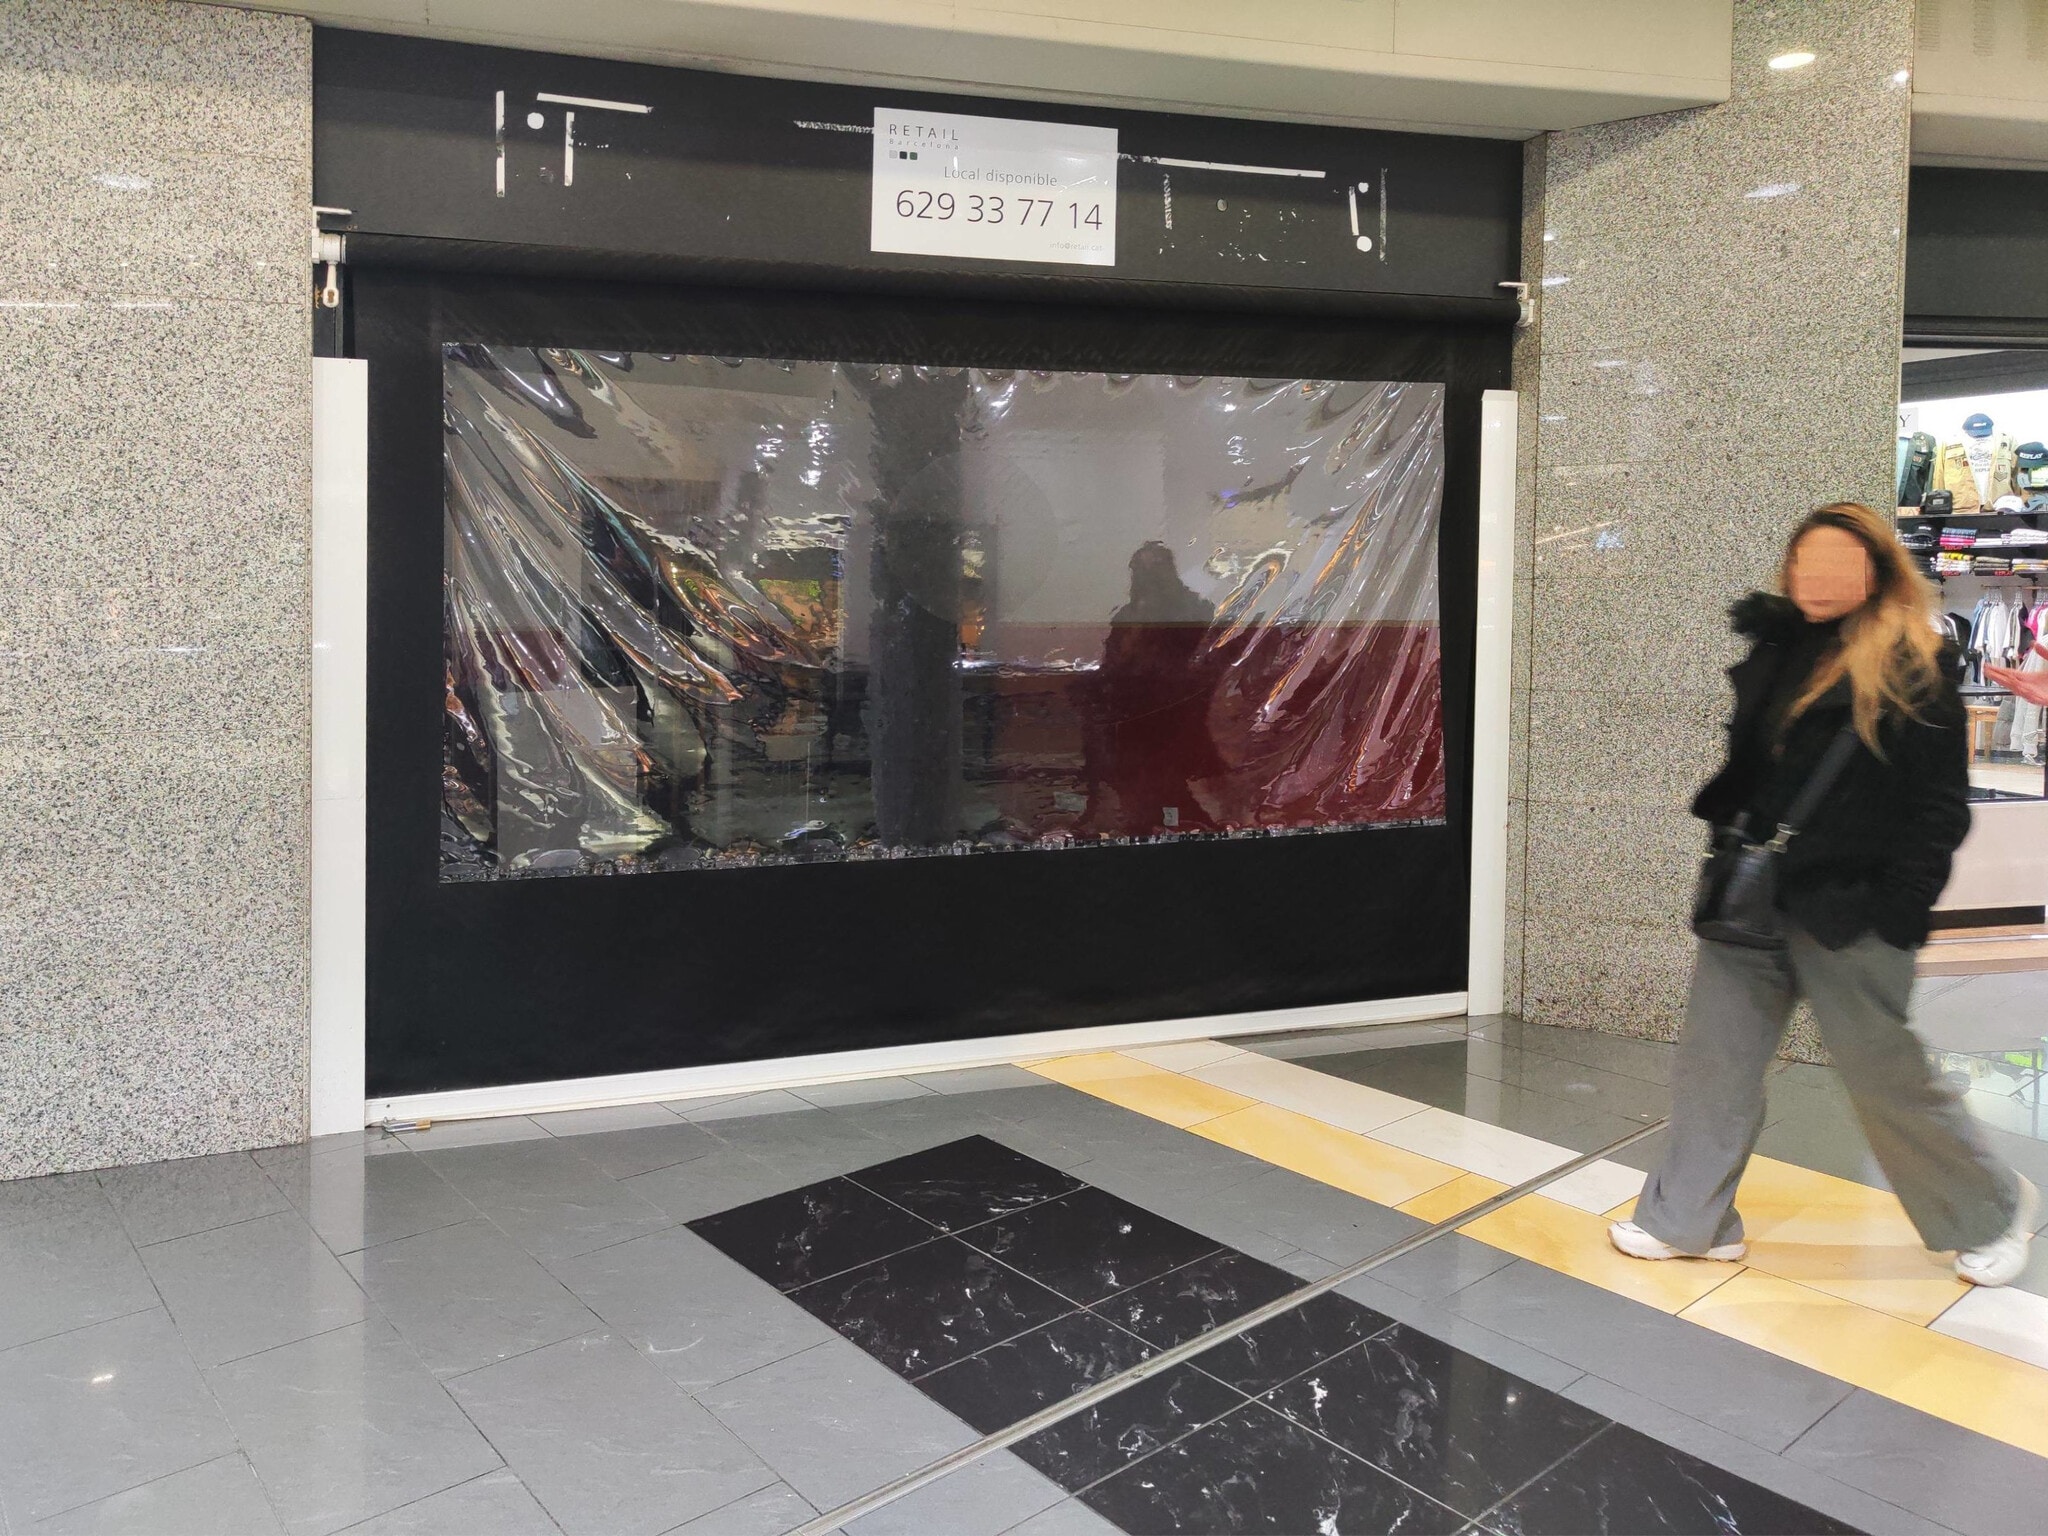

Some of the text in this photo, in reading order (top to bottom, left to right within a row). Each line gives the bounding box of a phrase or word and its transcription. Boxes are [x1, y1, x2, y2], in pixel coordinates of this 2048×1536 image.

[889, 123, 959, 141] RETAIL
[889, 138, 959, 150] Barcelona
[944, 166, 1058, 187] Local disponible
[896, 189, 1103, 230] 629 33 77 14
